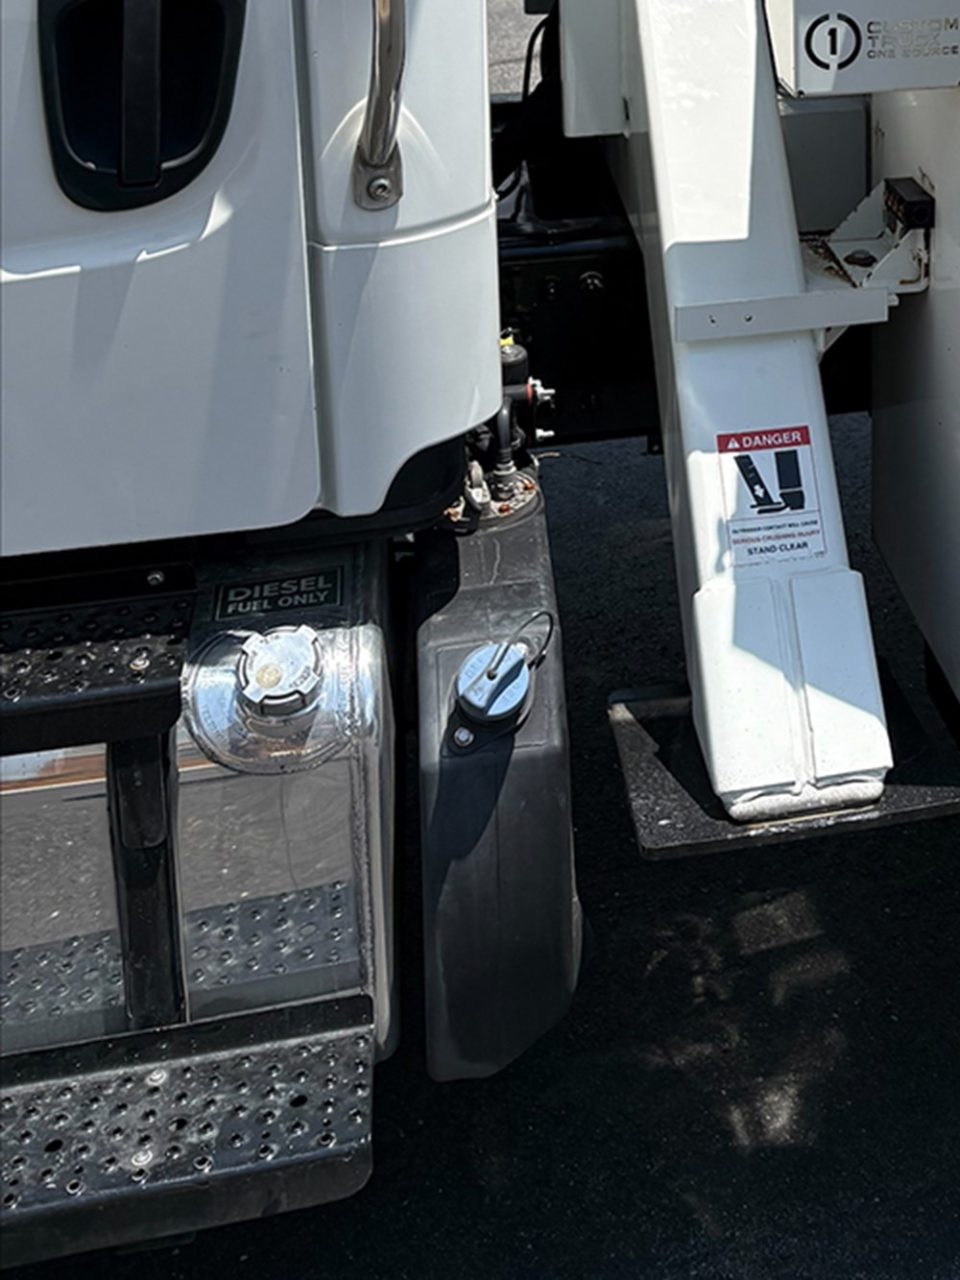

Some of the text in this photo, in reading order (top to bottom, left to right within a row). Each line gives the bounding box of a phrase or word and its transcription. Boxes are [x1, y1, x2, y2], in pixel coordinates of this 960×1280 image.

[866, 18, 959, 34] CUSTOM
[867, 33, 941, 48] TRUCK
[866, 45, 959, 59] ONE SOURCE
[742, 430, 802, 448] DANGER
[747, 541, 808, 556] STAND CLEAR
[228, 575, 332, 601] DIESEL
[227, 590, 329, 614] FUEL ONLY
